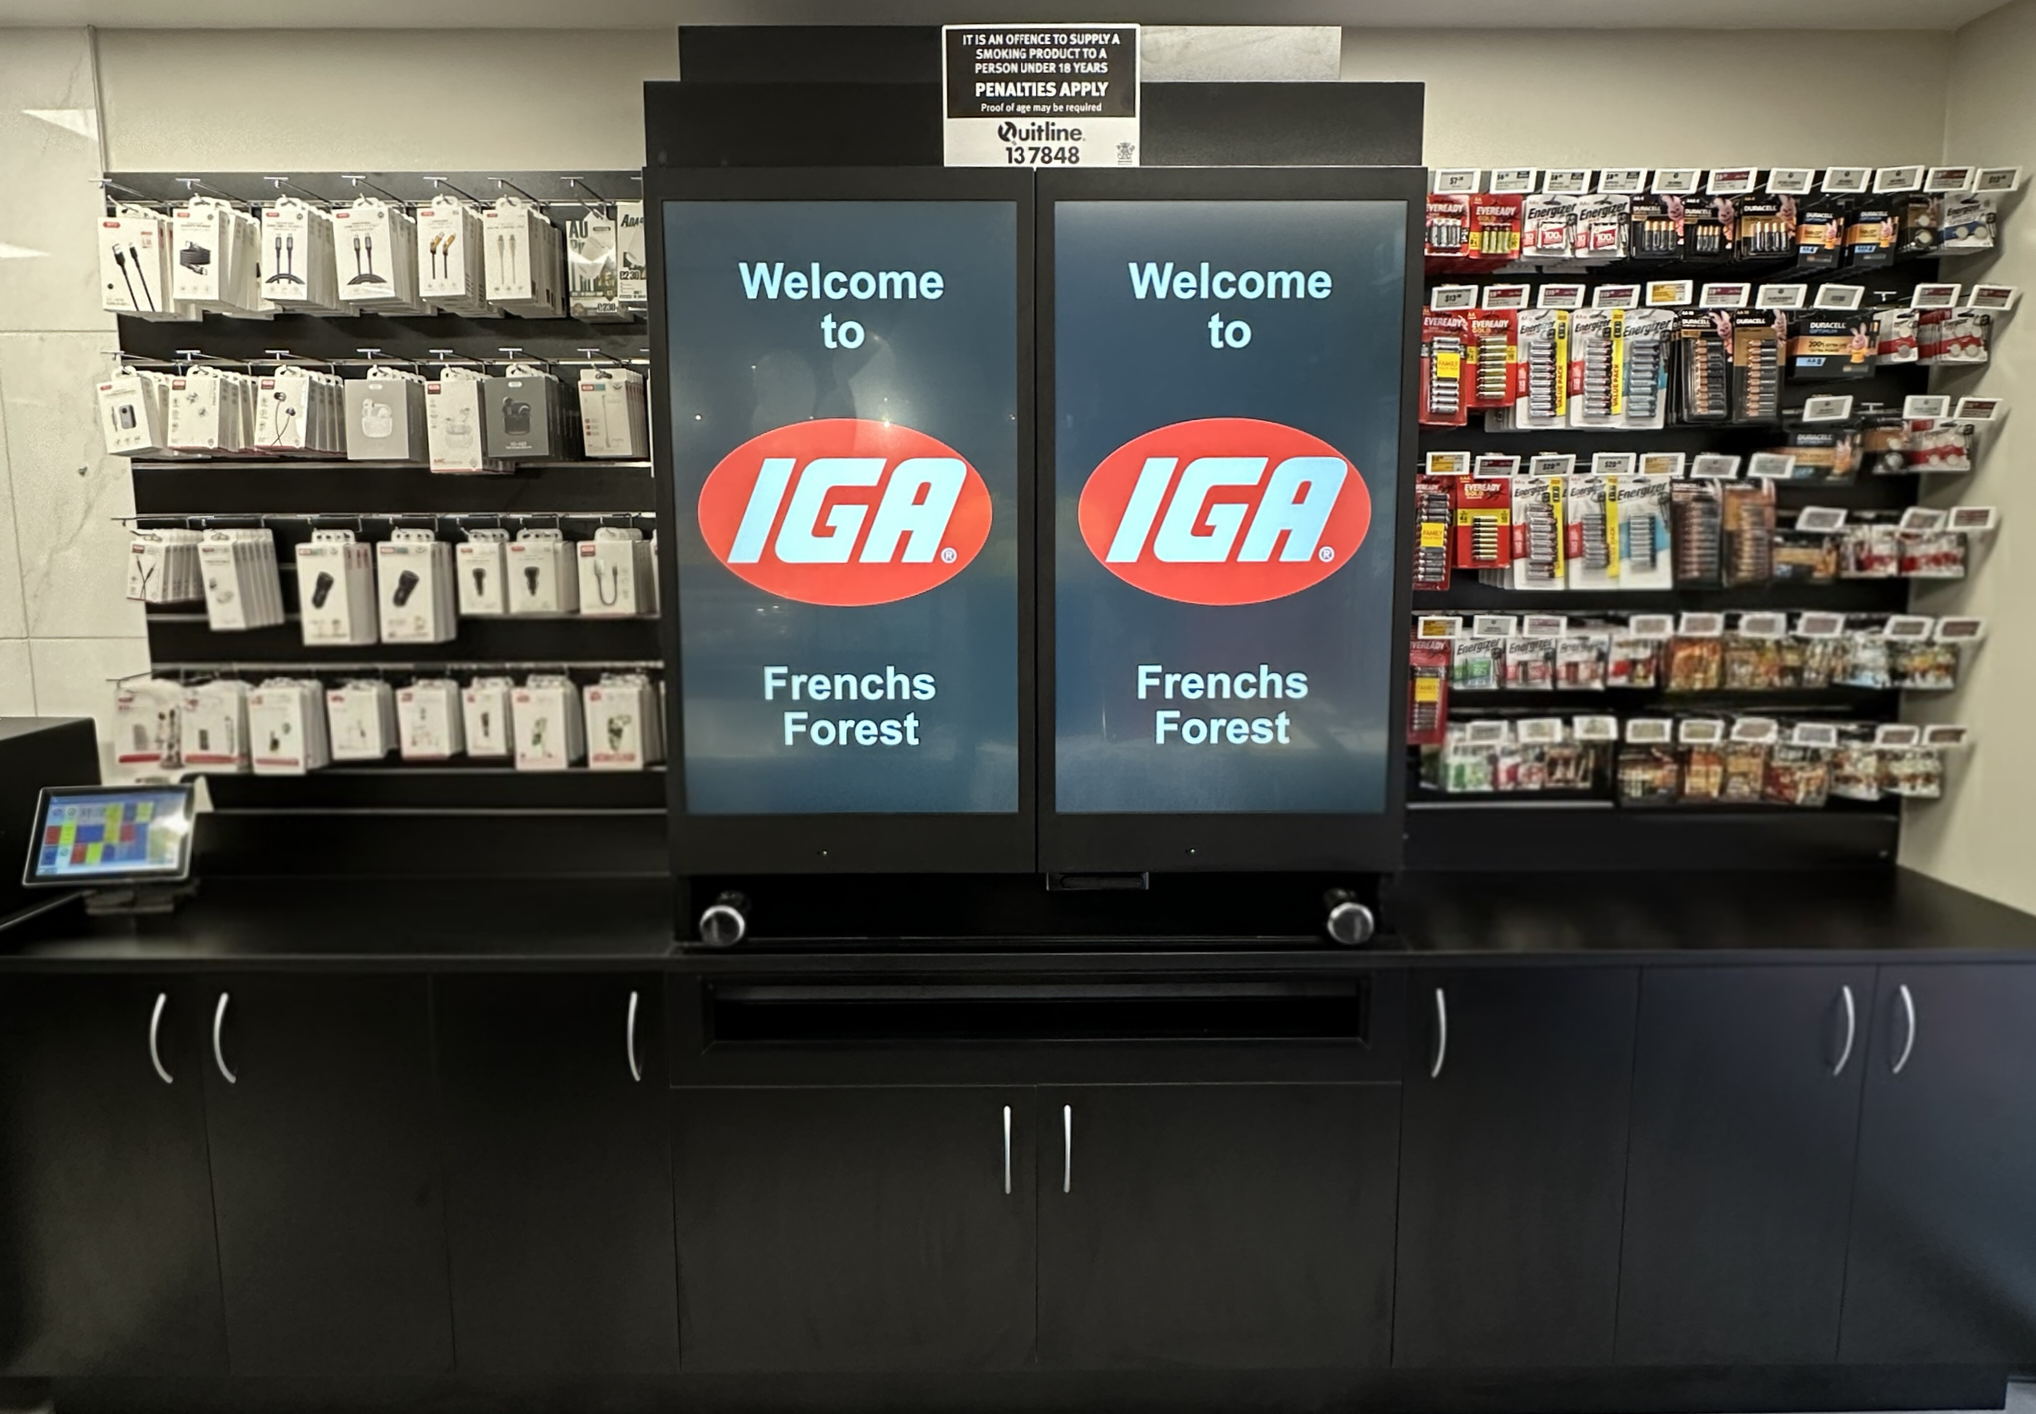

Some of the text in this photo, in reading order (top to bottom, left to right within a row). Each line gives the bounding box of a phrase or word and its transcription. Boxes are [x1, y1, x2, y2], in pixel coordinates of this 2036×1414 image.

[963, 33, 1120, 45] IT IS AN OFFENCE TO SUPPLY A
[976, 48, 1107, 60] SMOKING PRODUCT TO A
[975, 62, 1108, 74] PERSON UNDER 18 YEARS
[975, 82, 1109, 97] PENALTIES APPLY
[981, 103, 1102, 114] Proof of age may be required
[997, 121, 1083, 143] Quitline
[1476, 206, 1516, 216] EVEREADY
[1528, 203, 1577, 220] Energizer
[1580, 202, 1628, 221] Energizer
[569, 221, 588, 239] AU
[739, 262, 944, 299] Welcome
[1129, 262, 1332, 299] Welcome
[821, 313, 865, 349] to
[1208, 312, 1252, 349] to
[1424, 317, 1461, 327] EVEREADY
[1472, 320, 1508, 328] EVEREADY
[1520, 320, 1556, 335] Energizer
[1575, 318, 1612, 333] Energizer
[1623, 319, 1672, 338] Energizer
[1556, 365, 1564, 407] VALUE PACK
[1612, 364, 1620, 407] VALUE PACK
[1514, 485, 1549, 498] Energizer
[1618, 482, 1667, 501] Energizer
[727, 457, 968, 564] IGA
[1105, 456, 1348, 563] IGA
[1457, 638, 1501, 655] Energizer
[1509, 638, 1552, 654] Energizer
[765, 666, 936, 700] Frenchs
[1137, 665, 1309, 699] Frenchs
[785, 711, 919, 746] Forest
[1156, 710, 1291, 745] Forest
